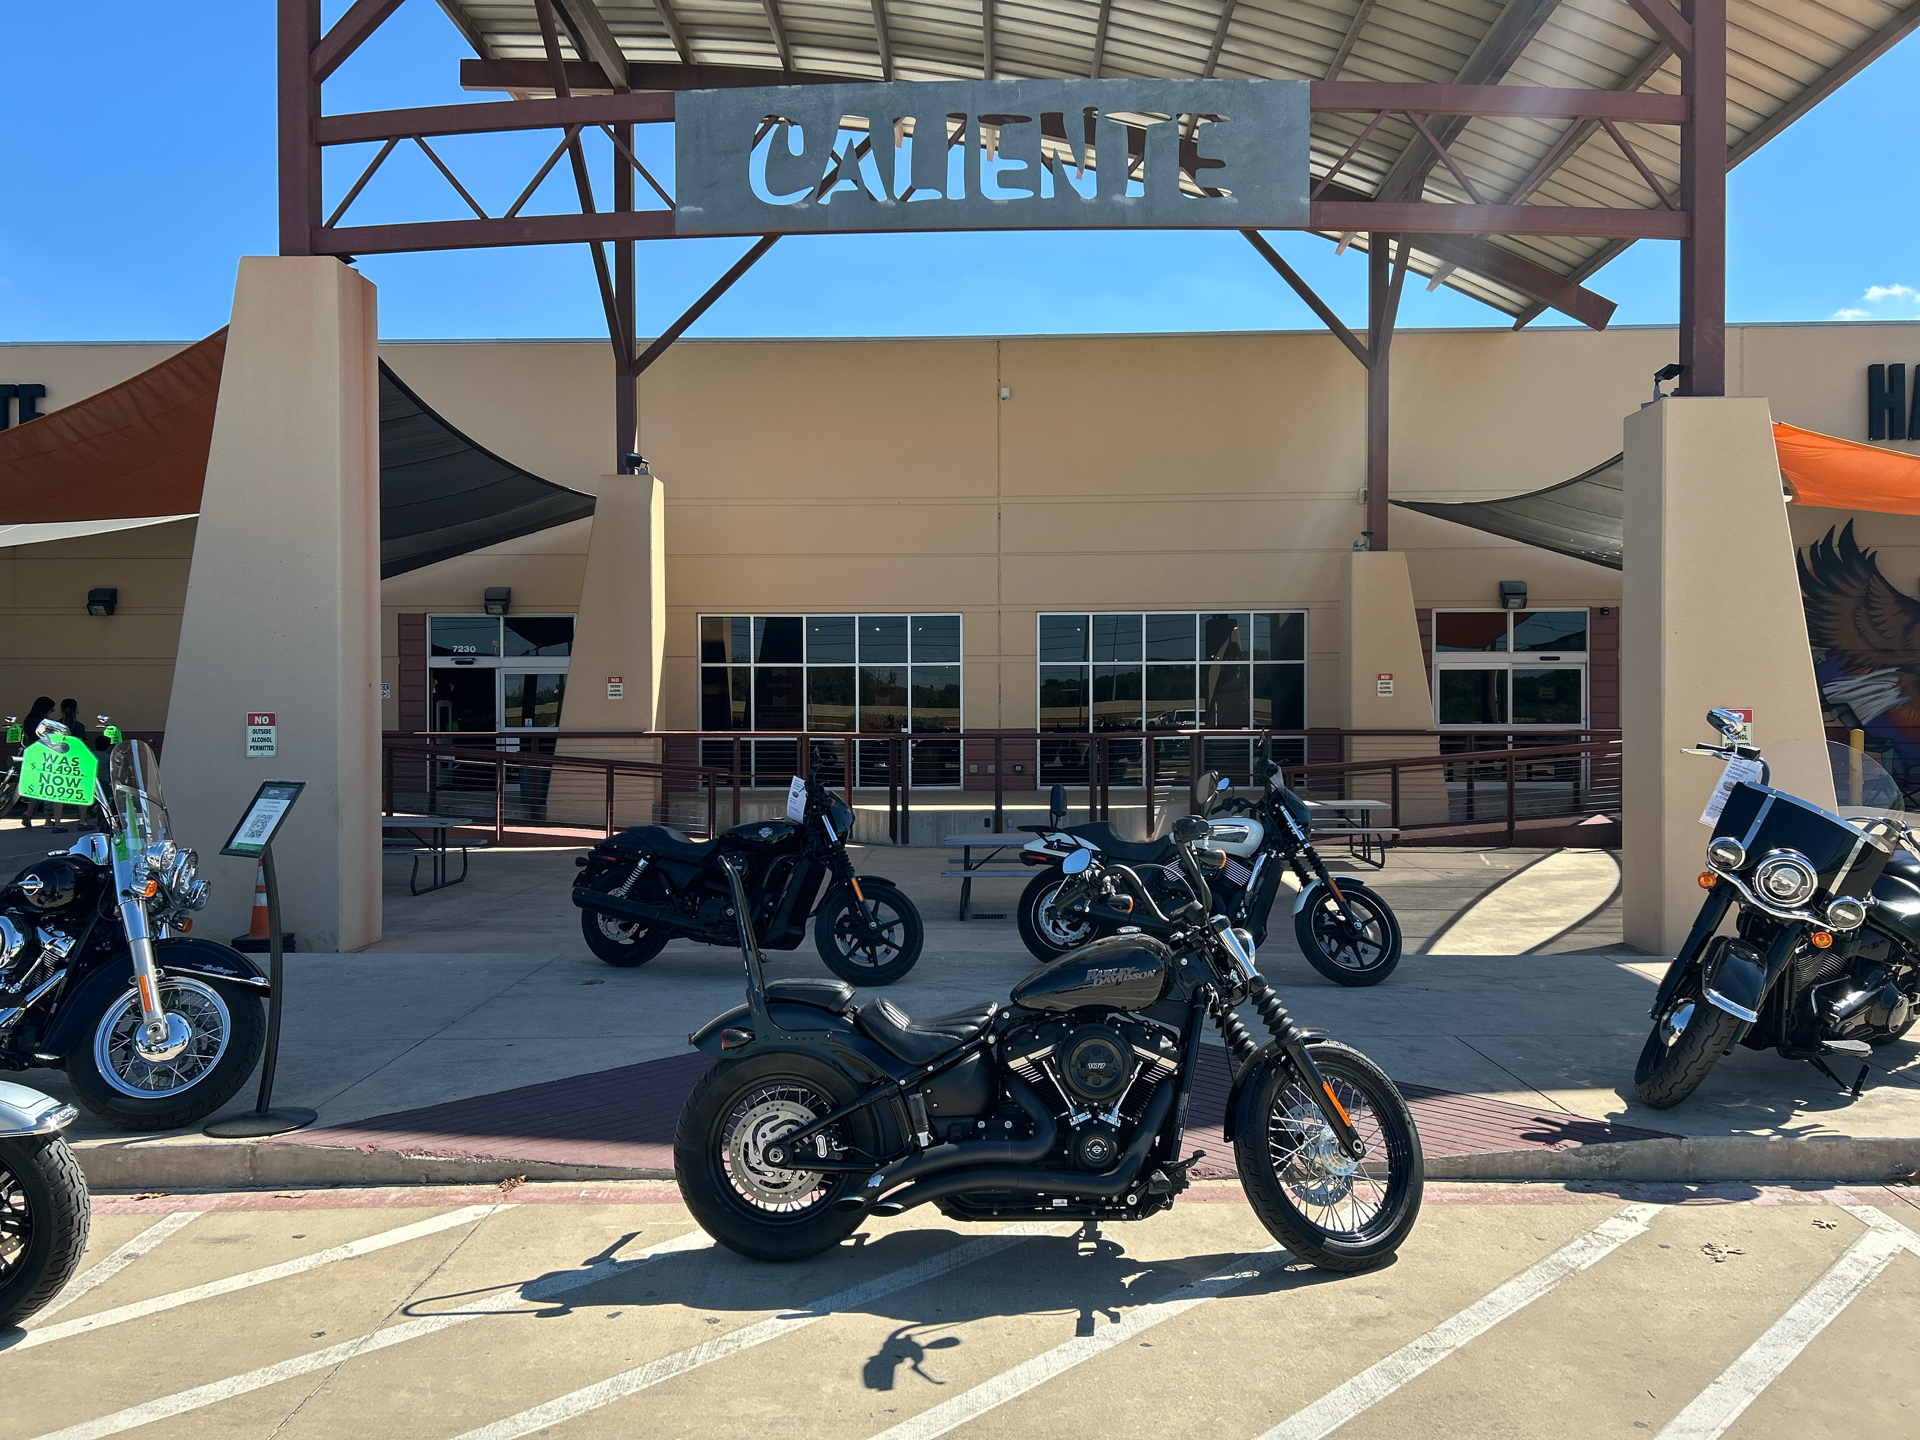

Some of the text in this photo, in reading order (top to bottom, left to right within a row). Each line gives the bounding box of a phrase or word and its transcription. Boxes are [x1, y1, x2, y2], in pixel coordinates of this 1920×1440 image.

[749, 106, 1233, 205] CALIENTE
[452, 645, 476, 653] 7230
[254, 716, 270, 724] NO
[42, 752, 80, 766] WAS
[38, 772, 82, 788] NOW
[1092, 970, 1156, 987] DAVIDSON
